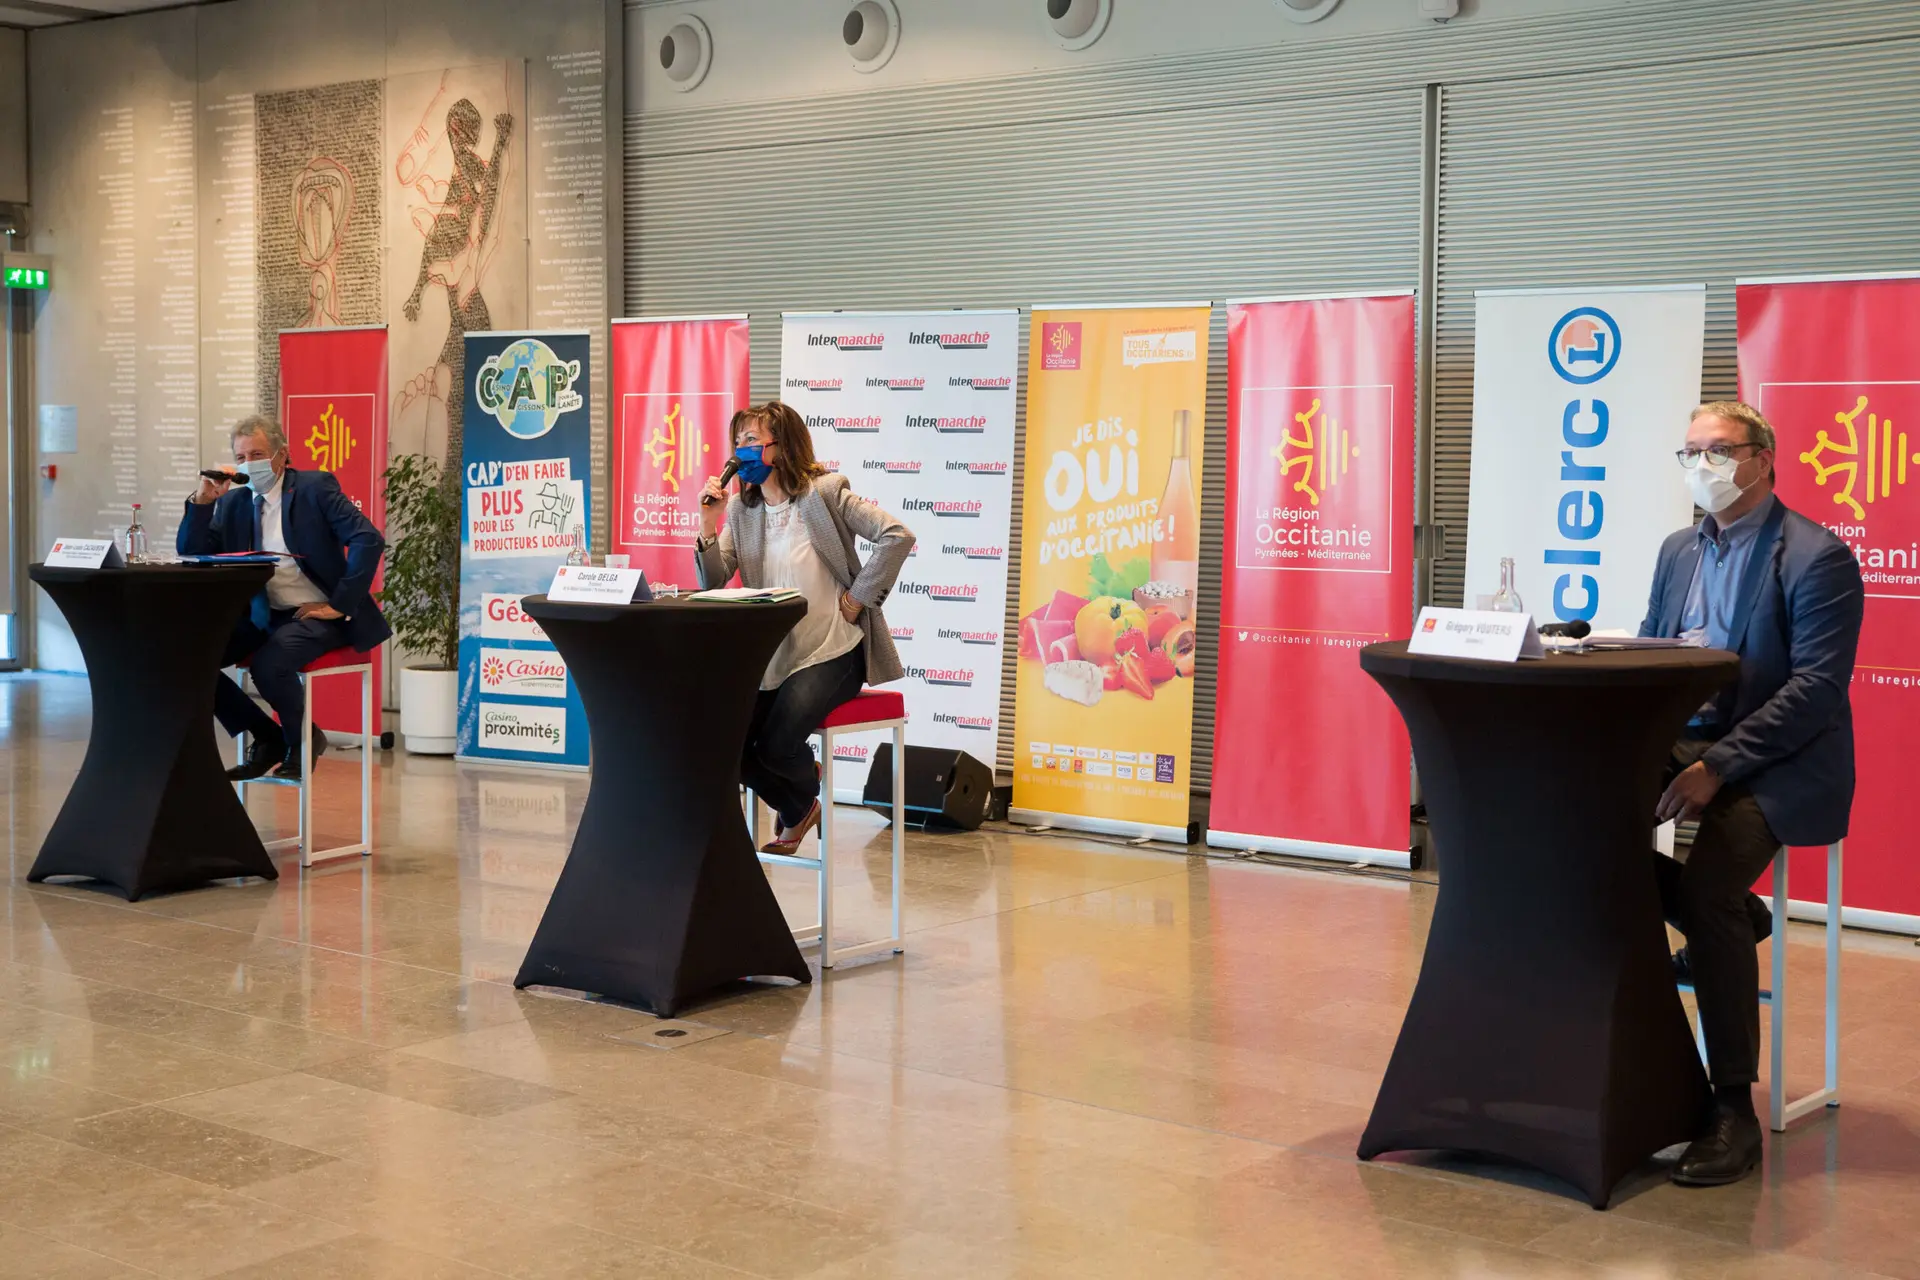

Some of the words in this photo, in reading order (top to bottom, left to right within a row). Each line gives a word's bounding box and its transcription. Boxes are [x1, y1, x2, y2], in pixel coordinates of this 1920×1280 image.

[808, 333, 884, 350] Intermarché
[909, 331, 990, 349] Intermarché
[1127, 339, 1150, 350] TOUS
[786, 378, 843, 391] Intermarché
[866, 377, 925, 390] Intermarché
[949, 377, 1011, 390] Intermarché
[806, 415, 881, 432] Intermarché
[906, 415, 986, 433] Intermarché
[1072, 427, 1093, 449] JE
[467, 460, 502, 487] CAP'
[505, 464, 529, 481] D'EN
[534, 461, 565, 479] FAIRE
[863, 460, 922, 473] Intermarché
[946, 461, 1007, 475] Intermarché
[482, 488, 524, 516] PLUS
[634, 494, 644, 504] La
[647, 493, 680, 507] Région
[902, 498, 982, 517] Intermarché
[634, 506, 701, 526] Occitan
[1256, 507, 1269, 519] La
[1273, 507, 1320, 522] Région
[473, 520, 497, 533] POUR
[500, 518, 515, 533] LES
[633, 527, 665, 537] Pyrénées
[671, 529, 700, 537] Méditer
[1046, 515, 1077, 536] AUX
[1256, 522, 1372, 546] Occitanie
[474, 535, 538, 552] PRODUCTEURS
[942, 544, 1002, 559] Intermarché
[1255, 548, 1299, 558] Pyrénées
[1307, 549, 1371, 560] Méditerranée
[578, 572, 597, 581] Carole
[597, 573, 618, 582] DELGA
[1862, 572, 1920, 585] éditerran
[899, 581, 978, 602] Intermarché
[1446, 621, 1473, 635] Grégory
[938, 628, 998, 645] Intermarché
[1252, 633, 1311, 645] @occitanie
[506, 659, 565, 678] Casino
[485, 711, 517, 722] Casino
[933, 713, 993, 730] Intermarché
[485, 721, 560, 743] proximités
